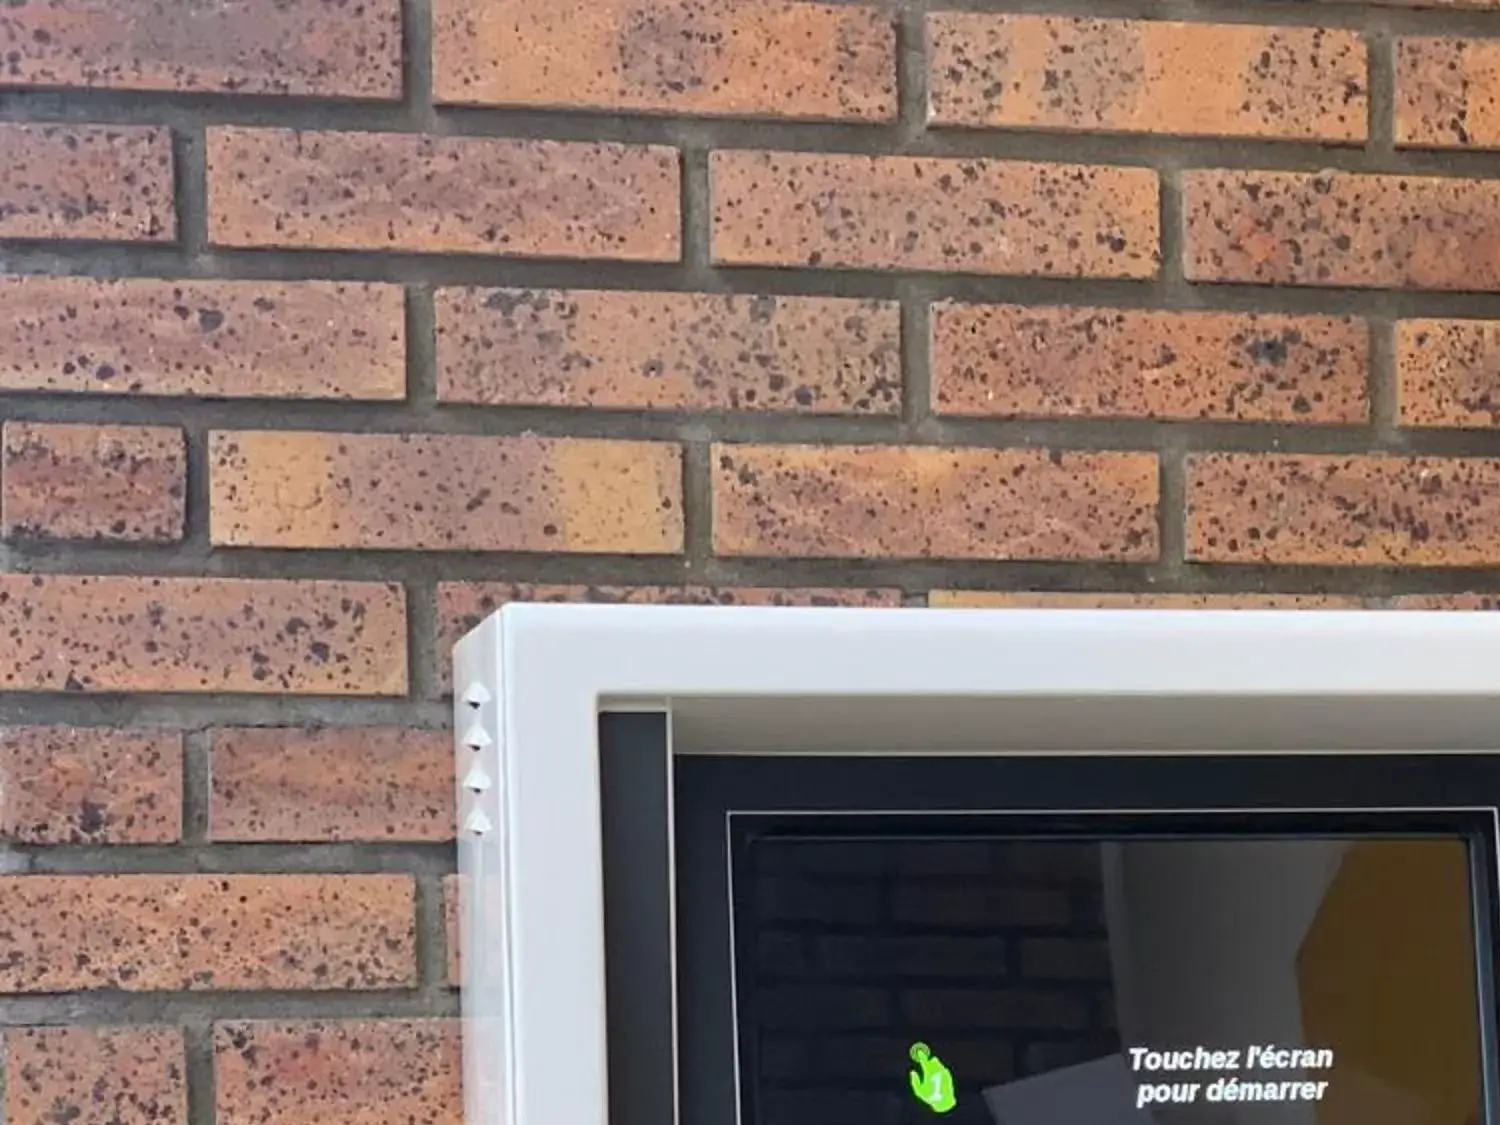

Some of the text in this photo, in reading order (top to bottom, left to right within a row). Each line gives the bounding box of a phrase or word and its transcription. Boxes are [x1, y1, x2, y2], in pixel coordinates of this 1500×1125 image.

[1128, 1044, 1334, 1072] Touchez l'écran
[1136, 1077, 1328, 1109] pour démarrer
